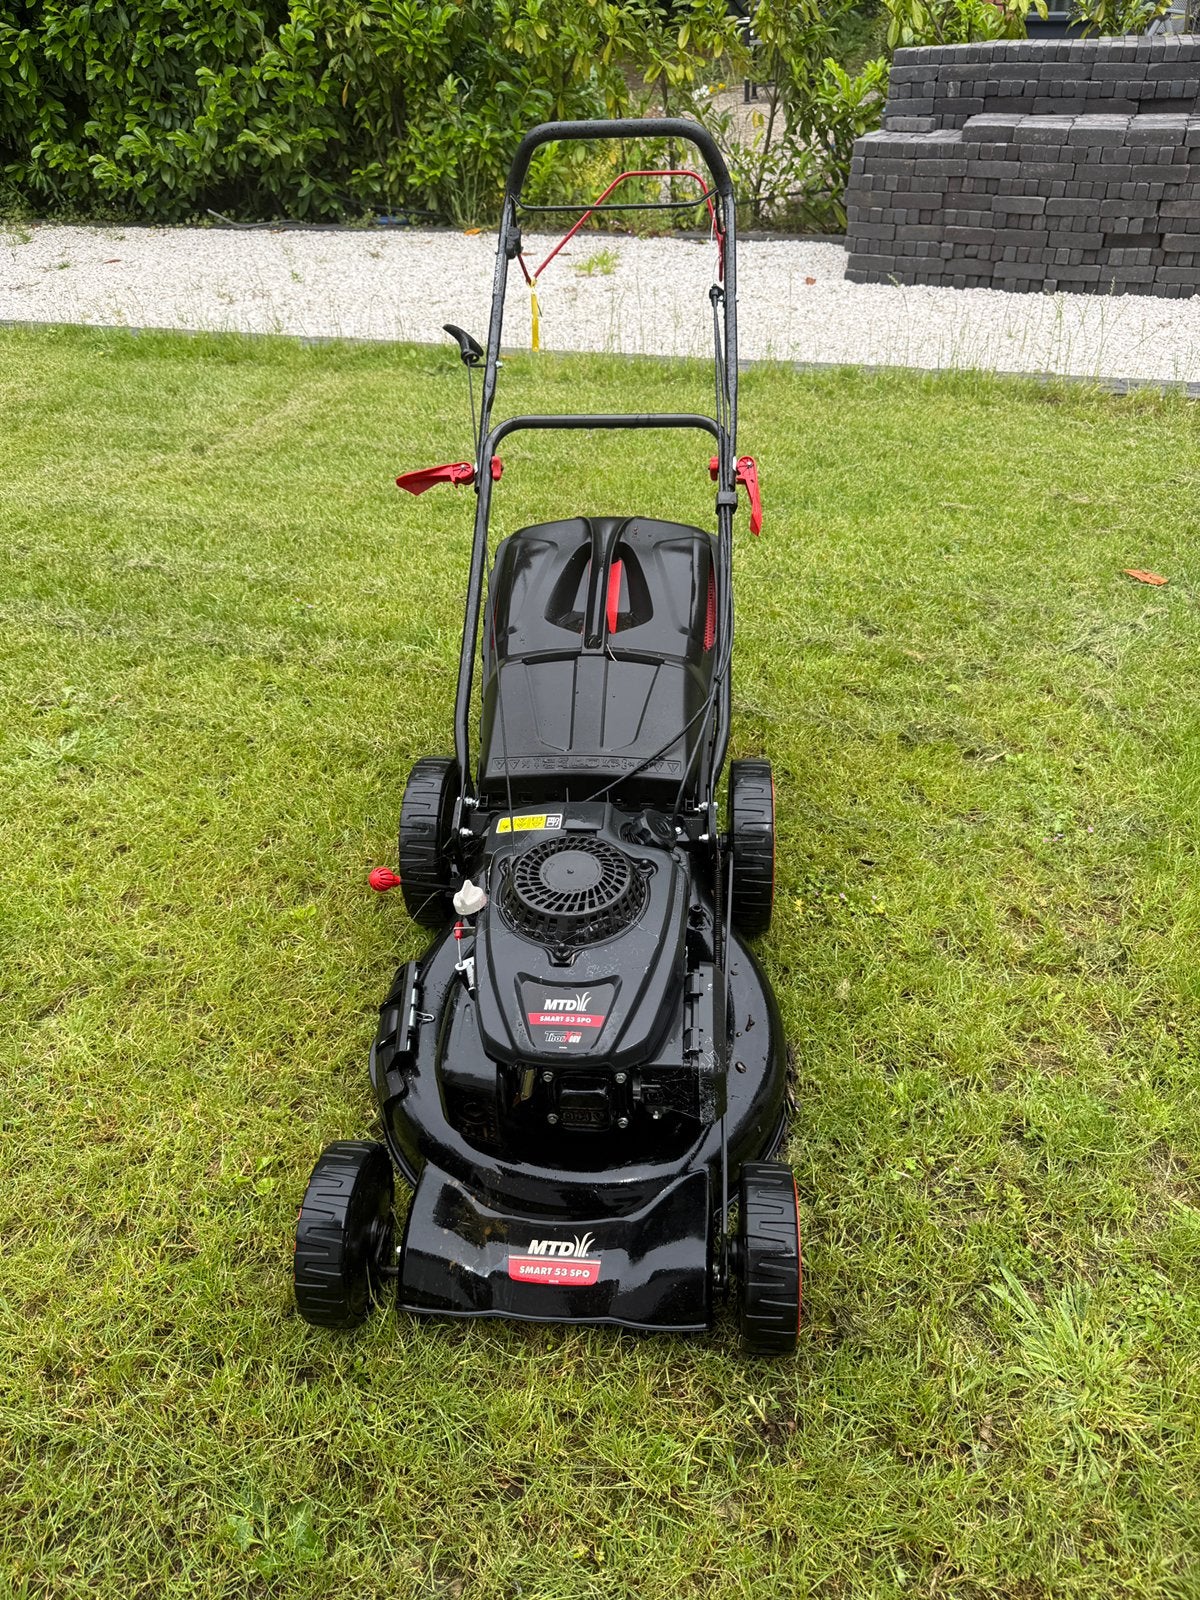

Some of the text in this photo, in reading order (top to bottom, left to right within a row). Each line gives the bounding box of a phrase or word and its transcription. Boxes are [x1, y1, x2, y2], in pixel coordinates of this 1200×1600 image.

[544, 999, 577, 1011] MTD
[527, 1239, 575, 1257] MTD
[519, 1265, 590, 1278] SMART 53 SPO
